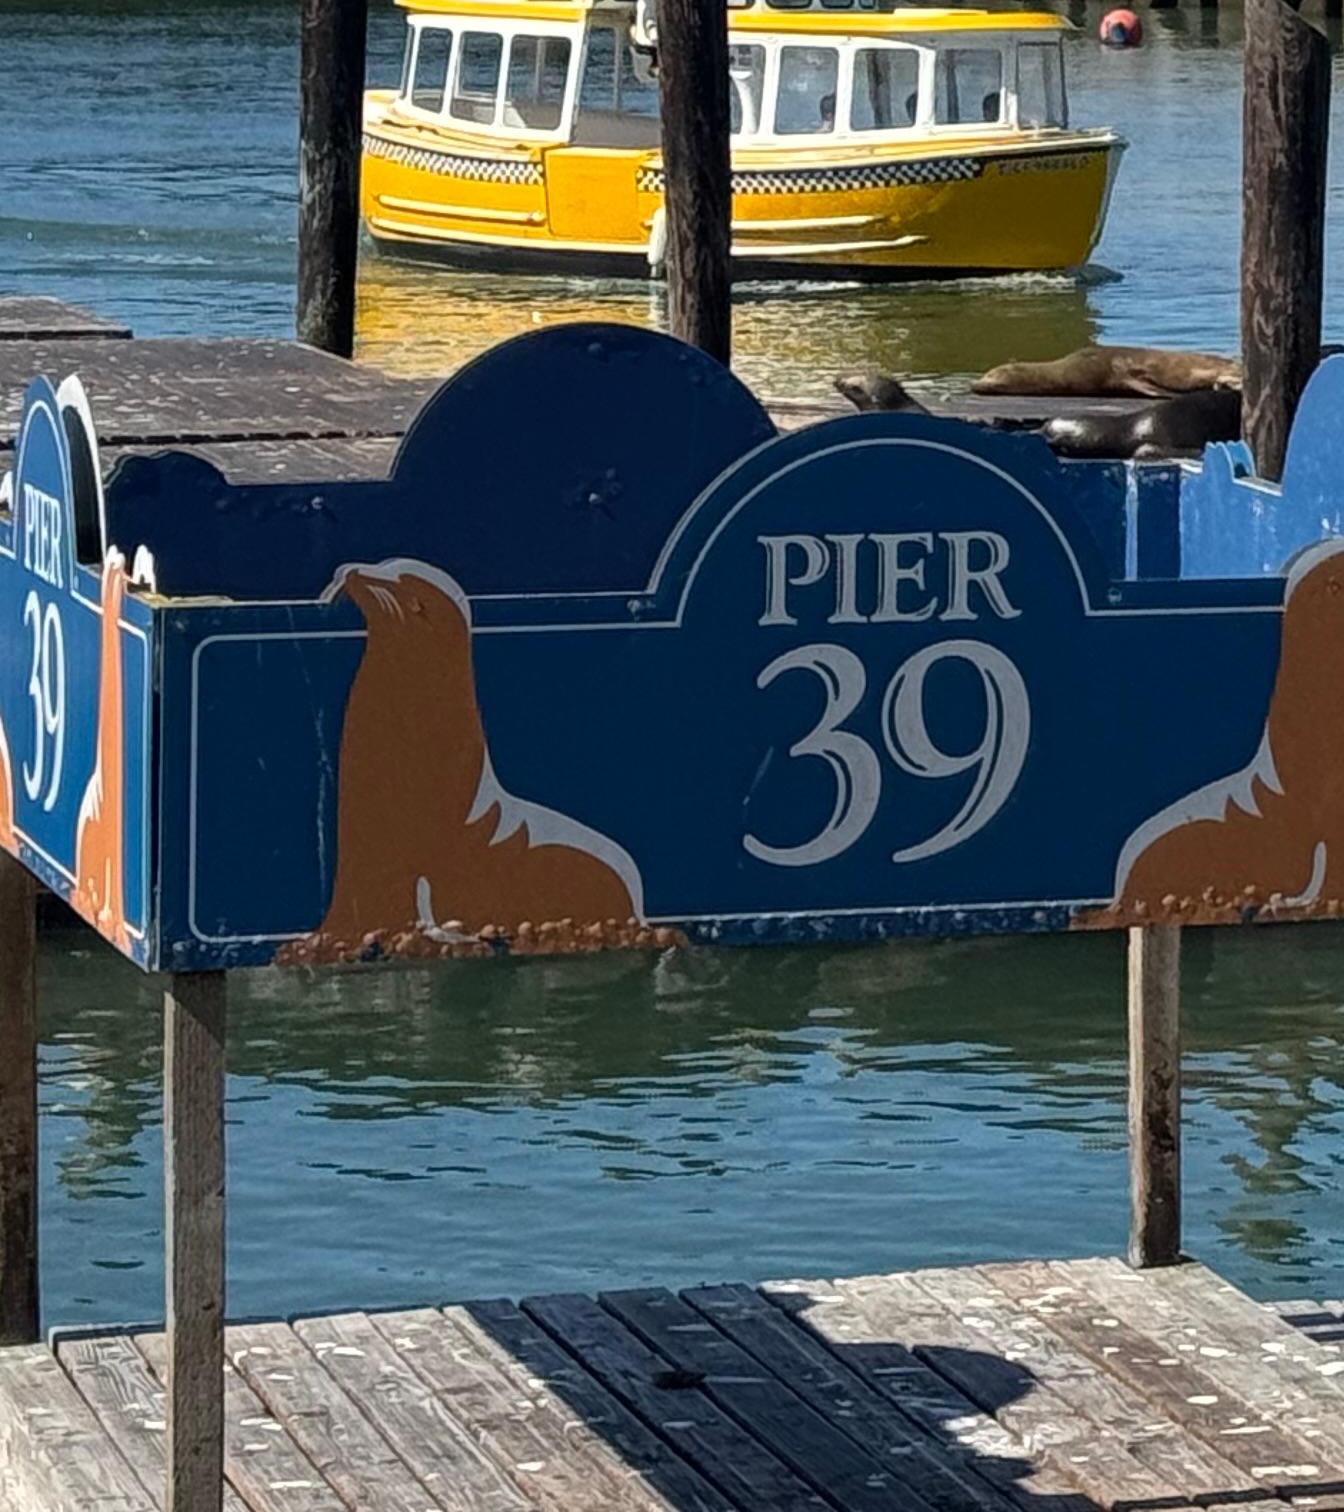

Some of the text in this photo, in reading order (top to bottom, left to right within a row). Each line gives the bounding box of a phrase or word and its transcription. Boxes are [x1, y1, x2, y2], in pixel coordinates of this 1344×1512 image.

[24, 483, 63, 589] PIER
[756, 530, 1022, 626] PIER
[23, 590, 65, 812] 39
[743, 639, 1030, 866] 39
